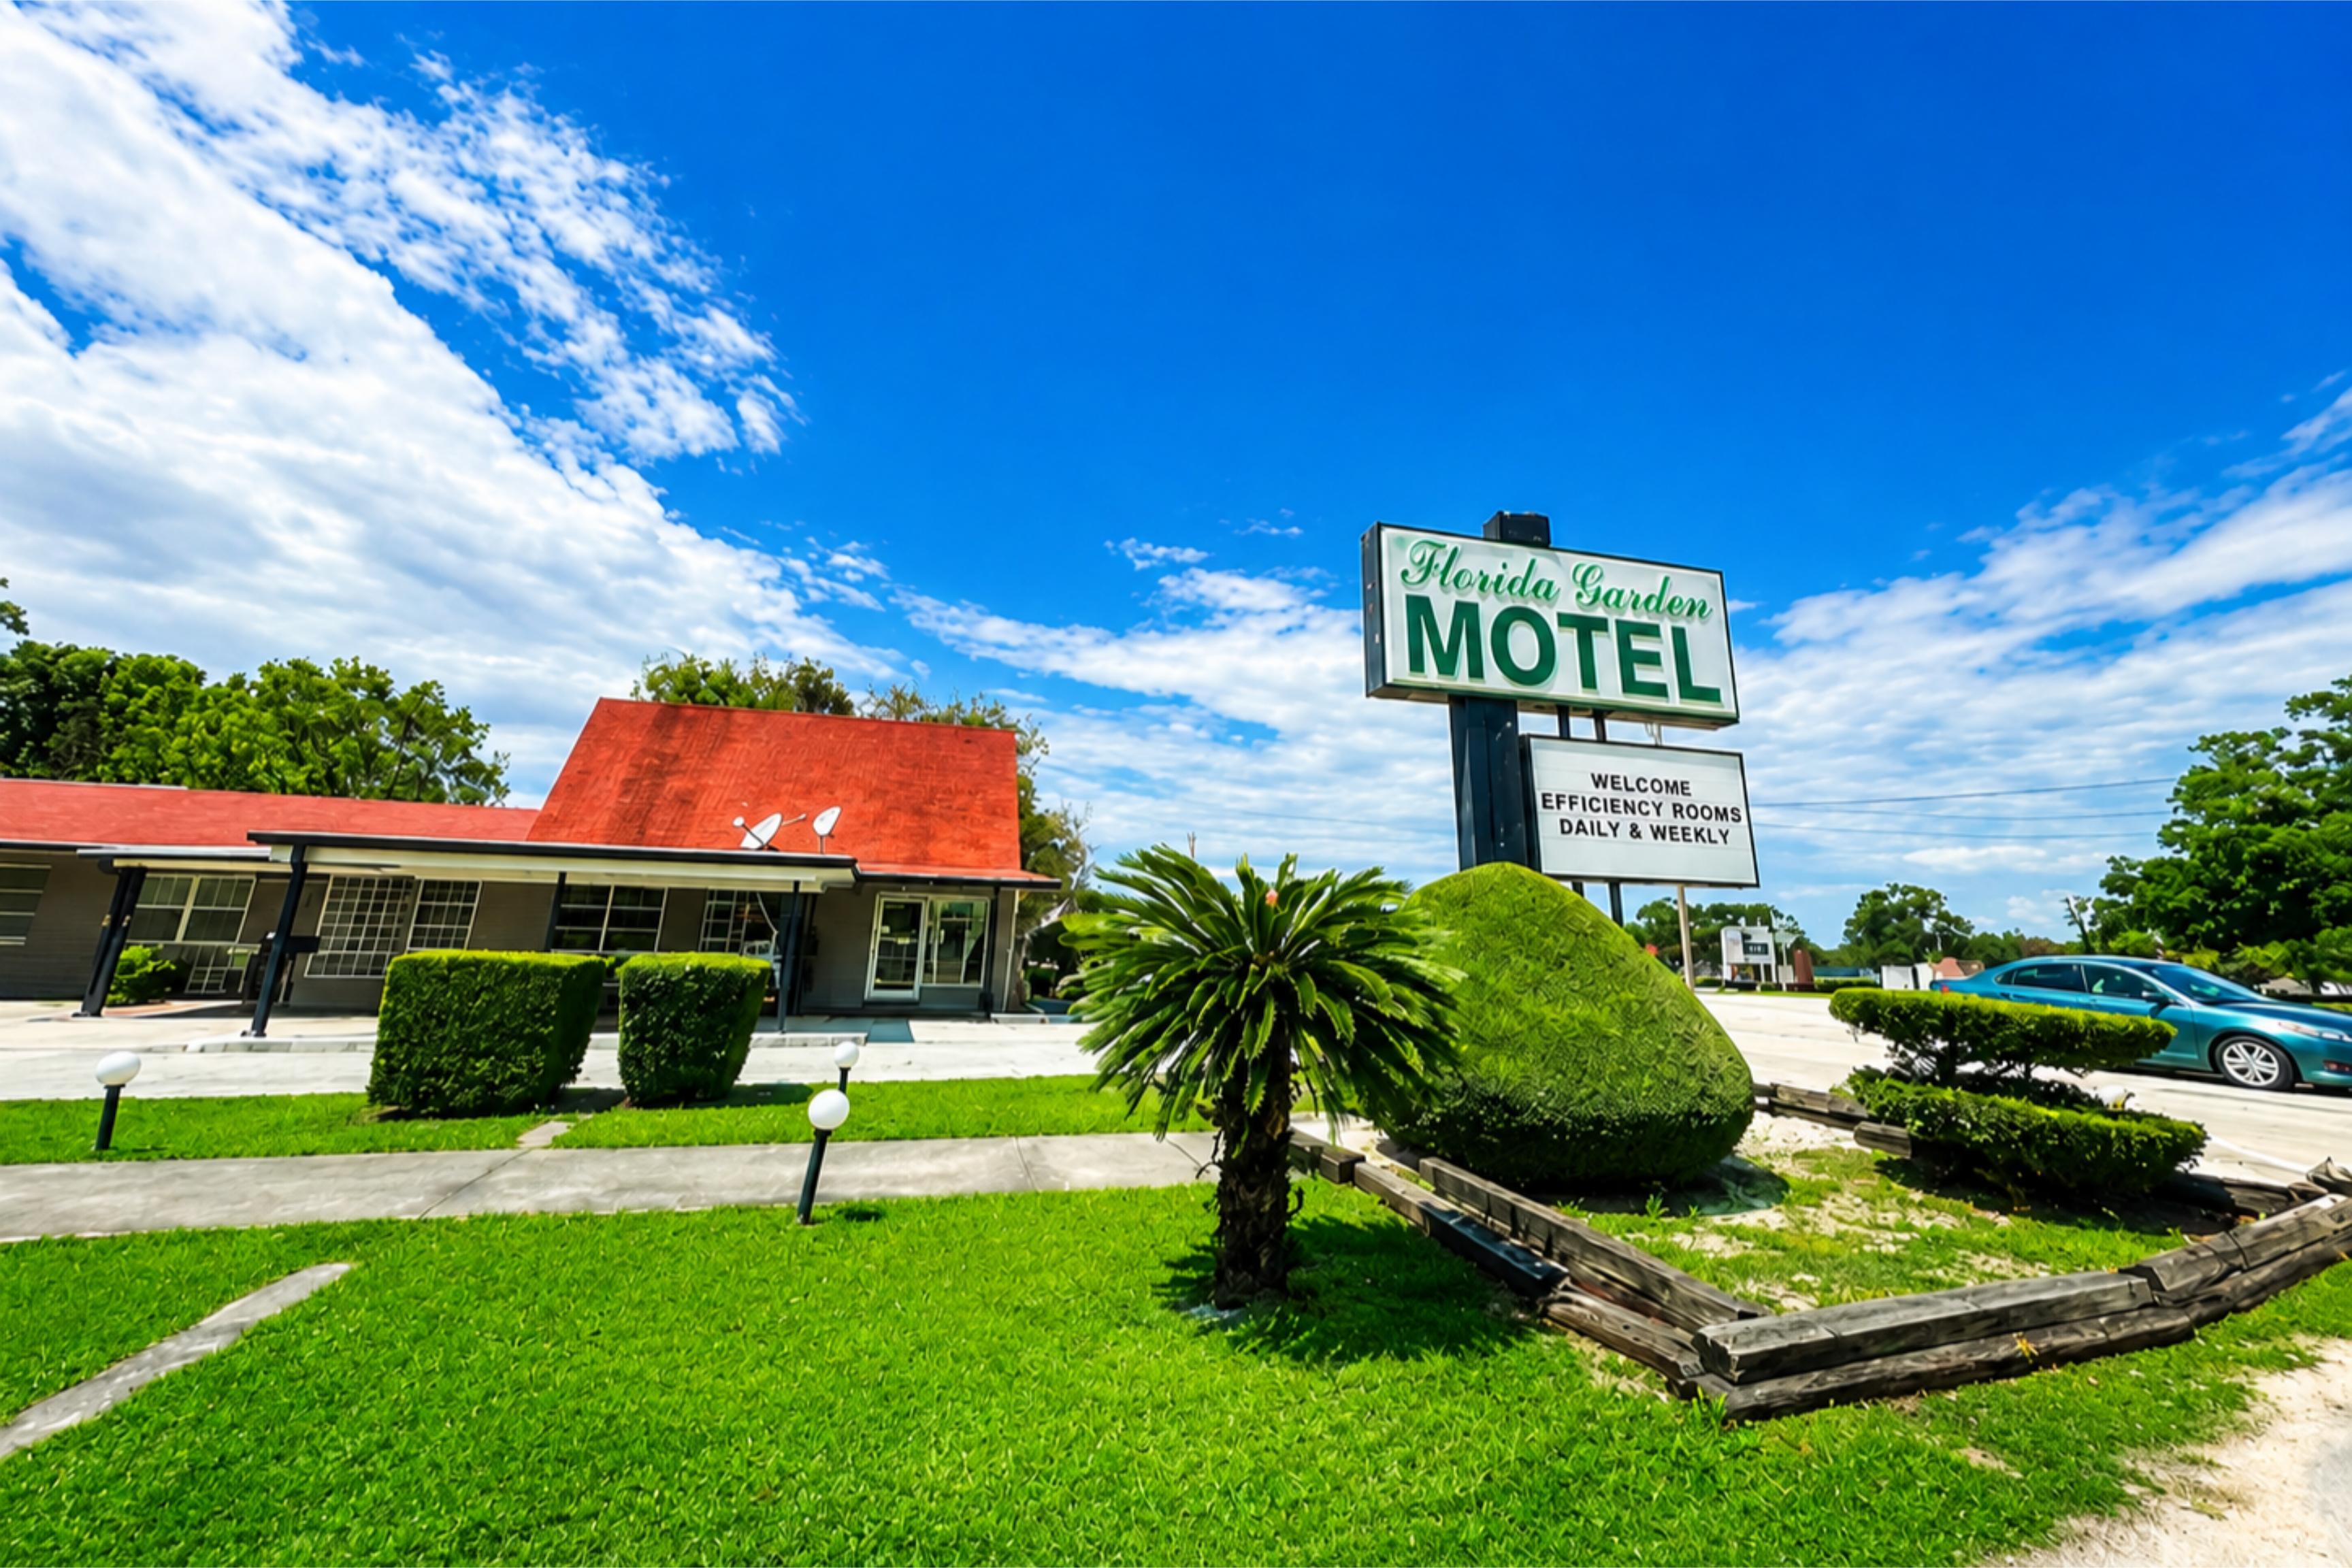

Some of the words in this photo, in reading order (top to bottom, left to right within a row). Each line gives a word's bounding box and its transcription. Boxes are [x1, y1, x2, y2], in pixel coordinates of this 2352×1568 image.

[1401, 540, 1561, 601] Florida
[1573, 563, 1712, 619] Garden
[1405, 594, 1722, 703] MOTEL
[1590, 772, 1692, 797] WELCOME
[1541, 792, 1663, 817] EFFICIENCY
[1672, 802, 1742, 823] ROOMS
[1559, 818, 1620, 838] DAILY
[1629, 823, 1643, 840] &
[1650, 824, 1730, 845] WEEKLY
